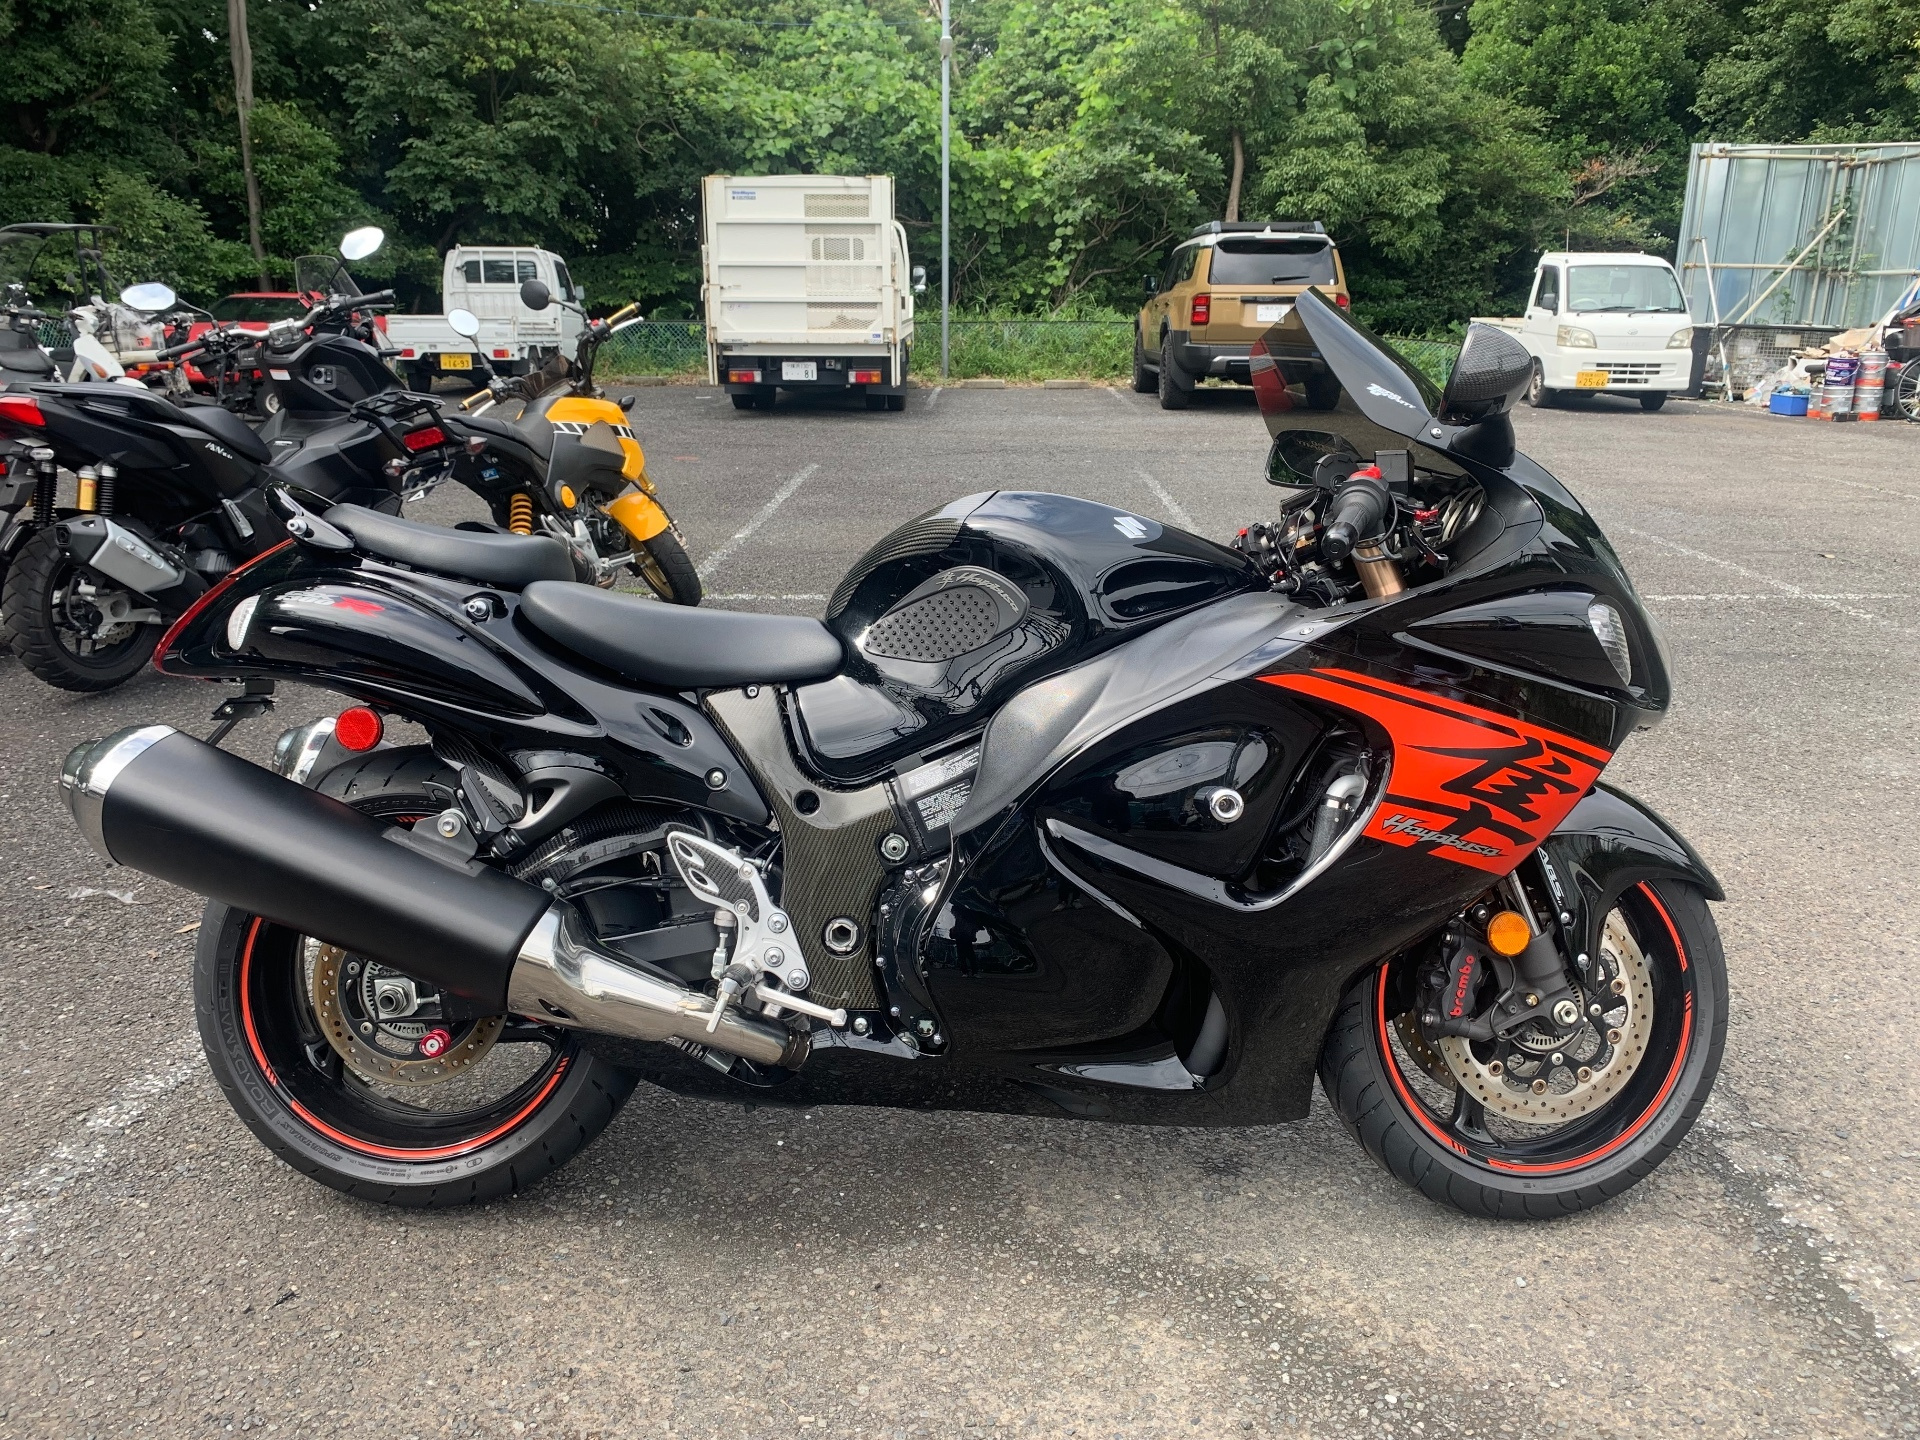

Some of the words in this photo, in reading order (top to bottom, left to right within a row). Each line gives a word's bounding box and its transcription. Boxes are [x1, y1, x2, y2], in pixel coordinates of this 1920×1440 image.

[1583, 378, 1606, 387] 25-66
[956, 572, 1020, 614] Hayabusa
[1401, 735, 1581, 852] 隼
[1382, 814, 1510, 858] Hayabusa
[1537, 846, 1565, 900] ABS
[1449, 955, 1475, 1016] brembo
[217, 981, 277, 1116] ROADSMART
